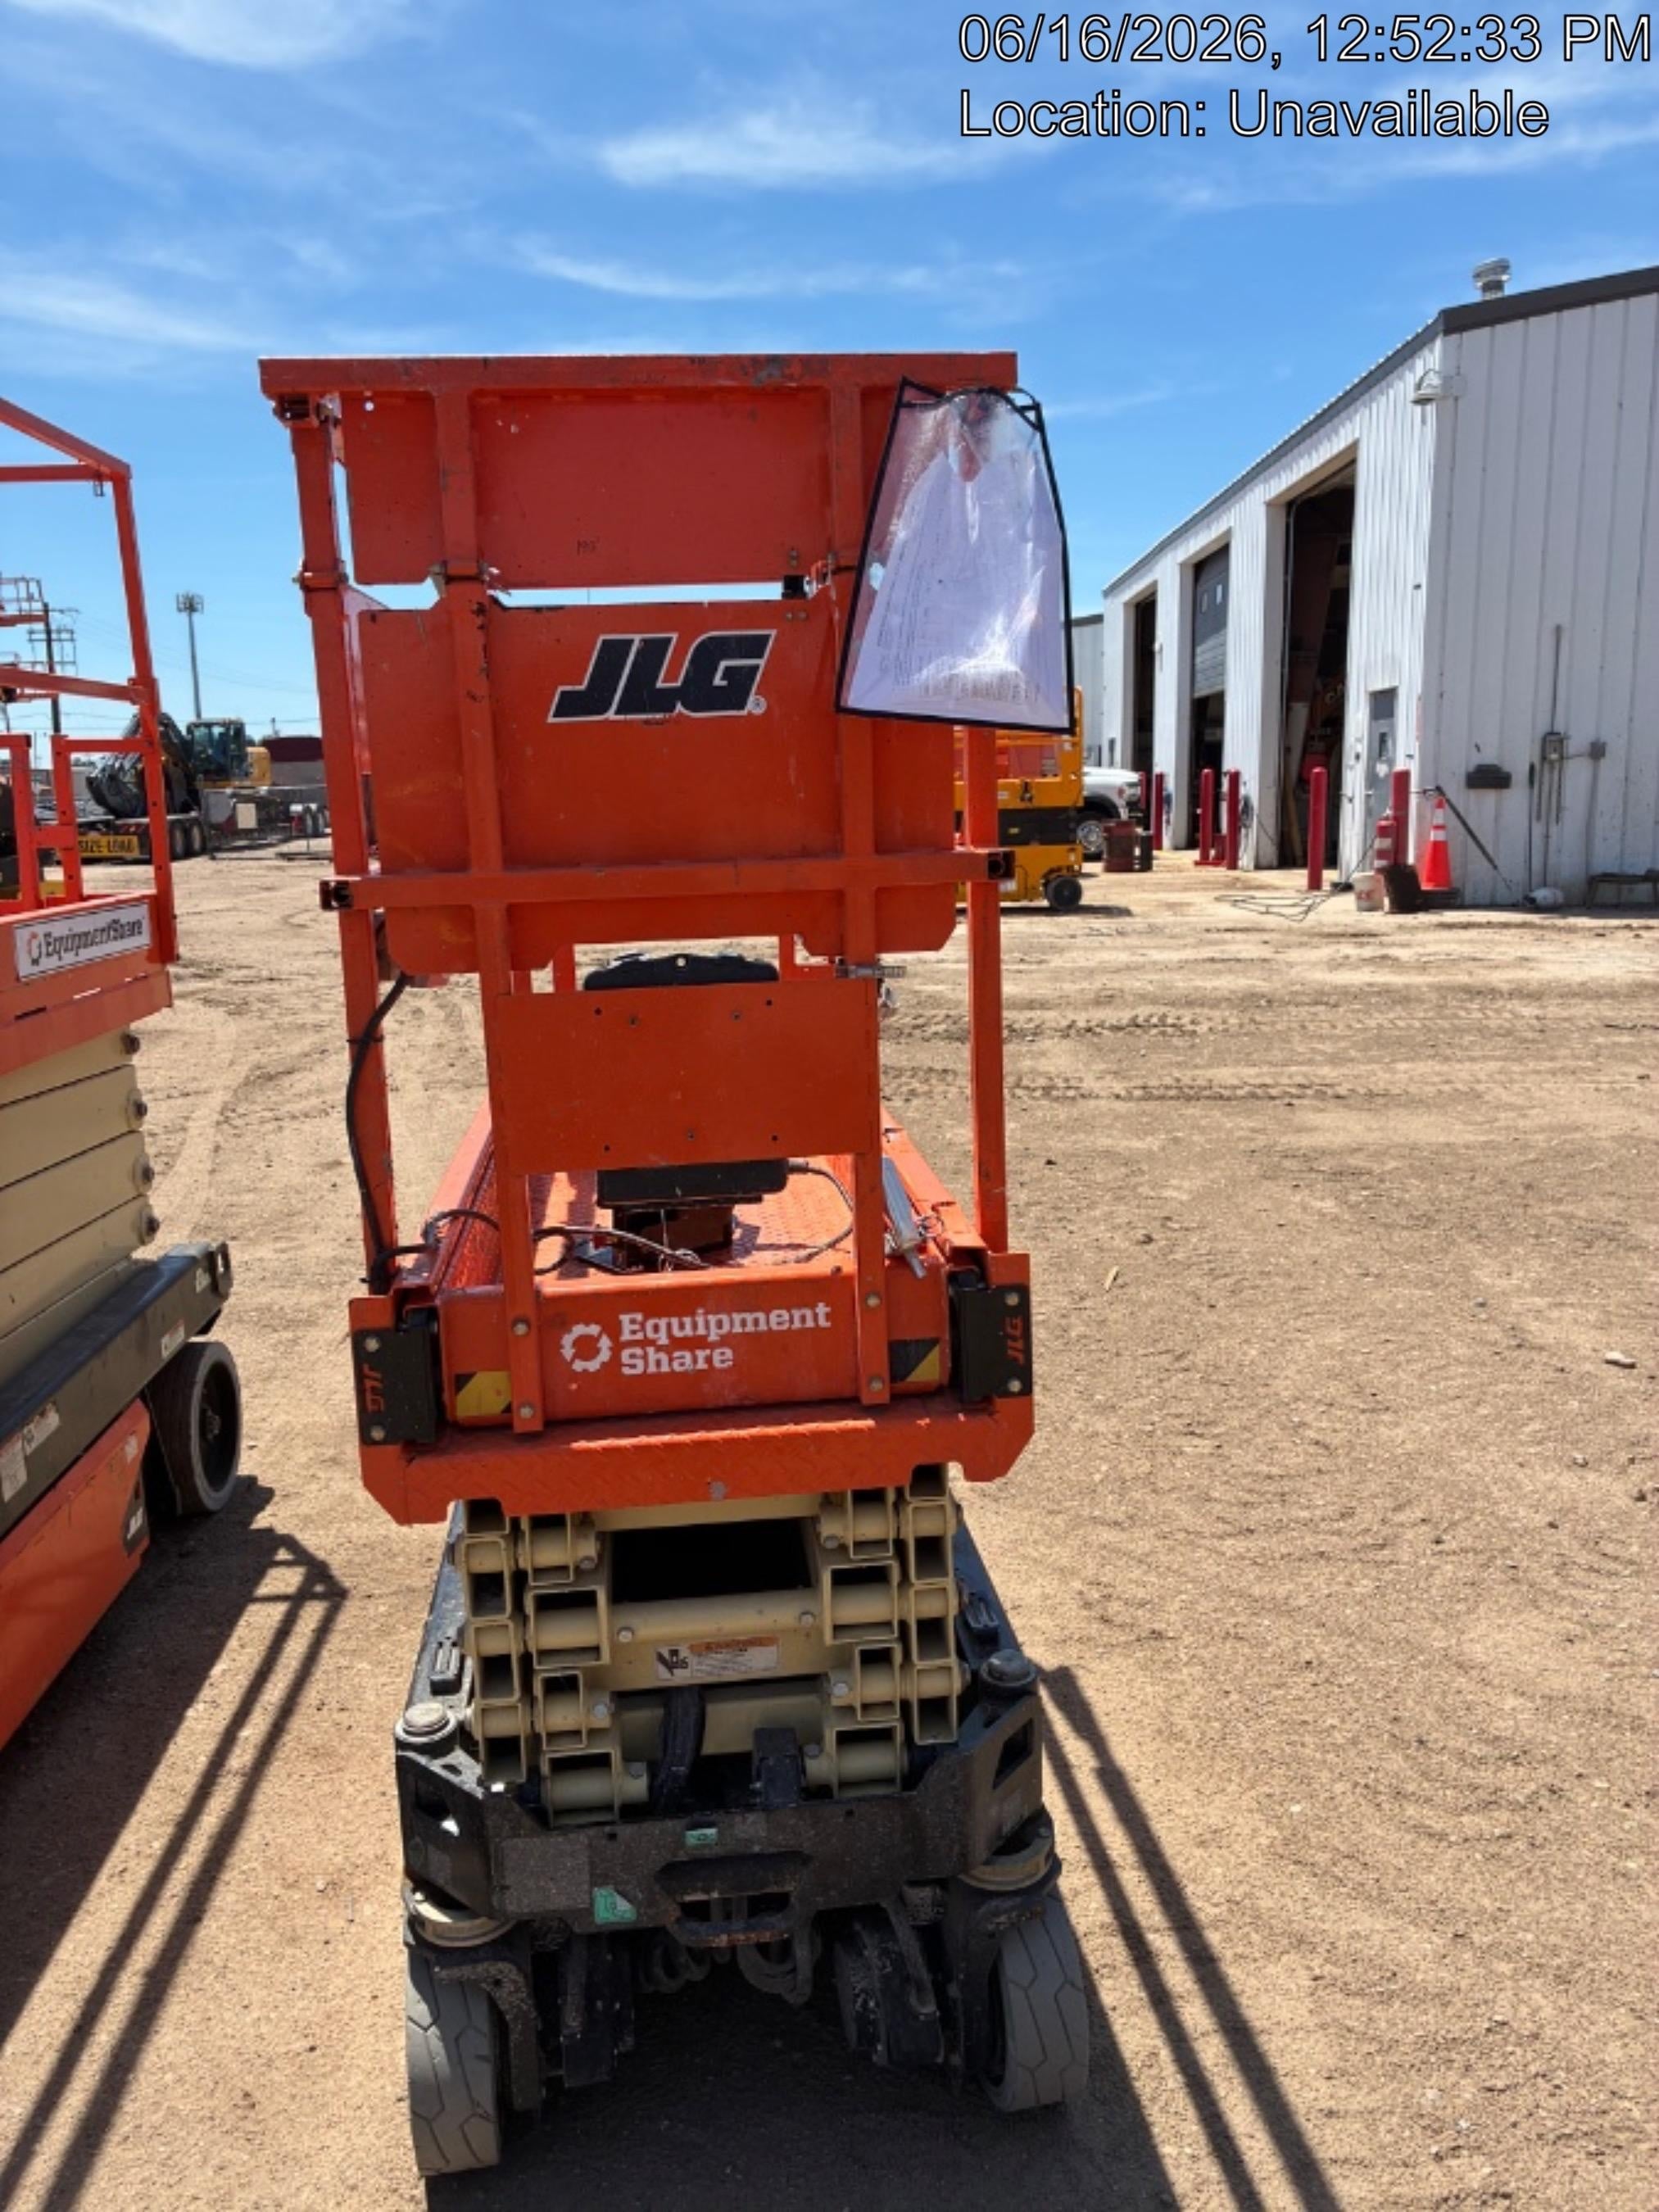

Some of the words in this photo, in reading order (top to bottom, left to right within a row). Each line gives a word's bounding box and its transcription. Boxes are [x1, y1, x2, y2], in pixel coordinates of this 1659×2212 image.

[43, 918, 143, 962] EquipmentShare
[619, 1302, 832, 1345] Equipment
[620, 1346, 734, 1376] Share
